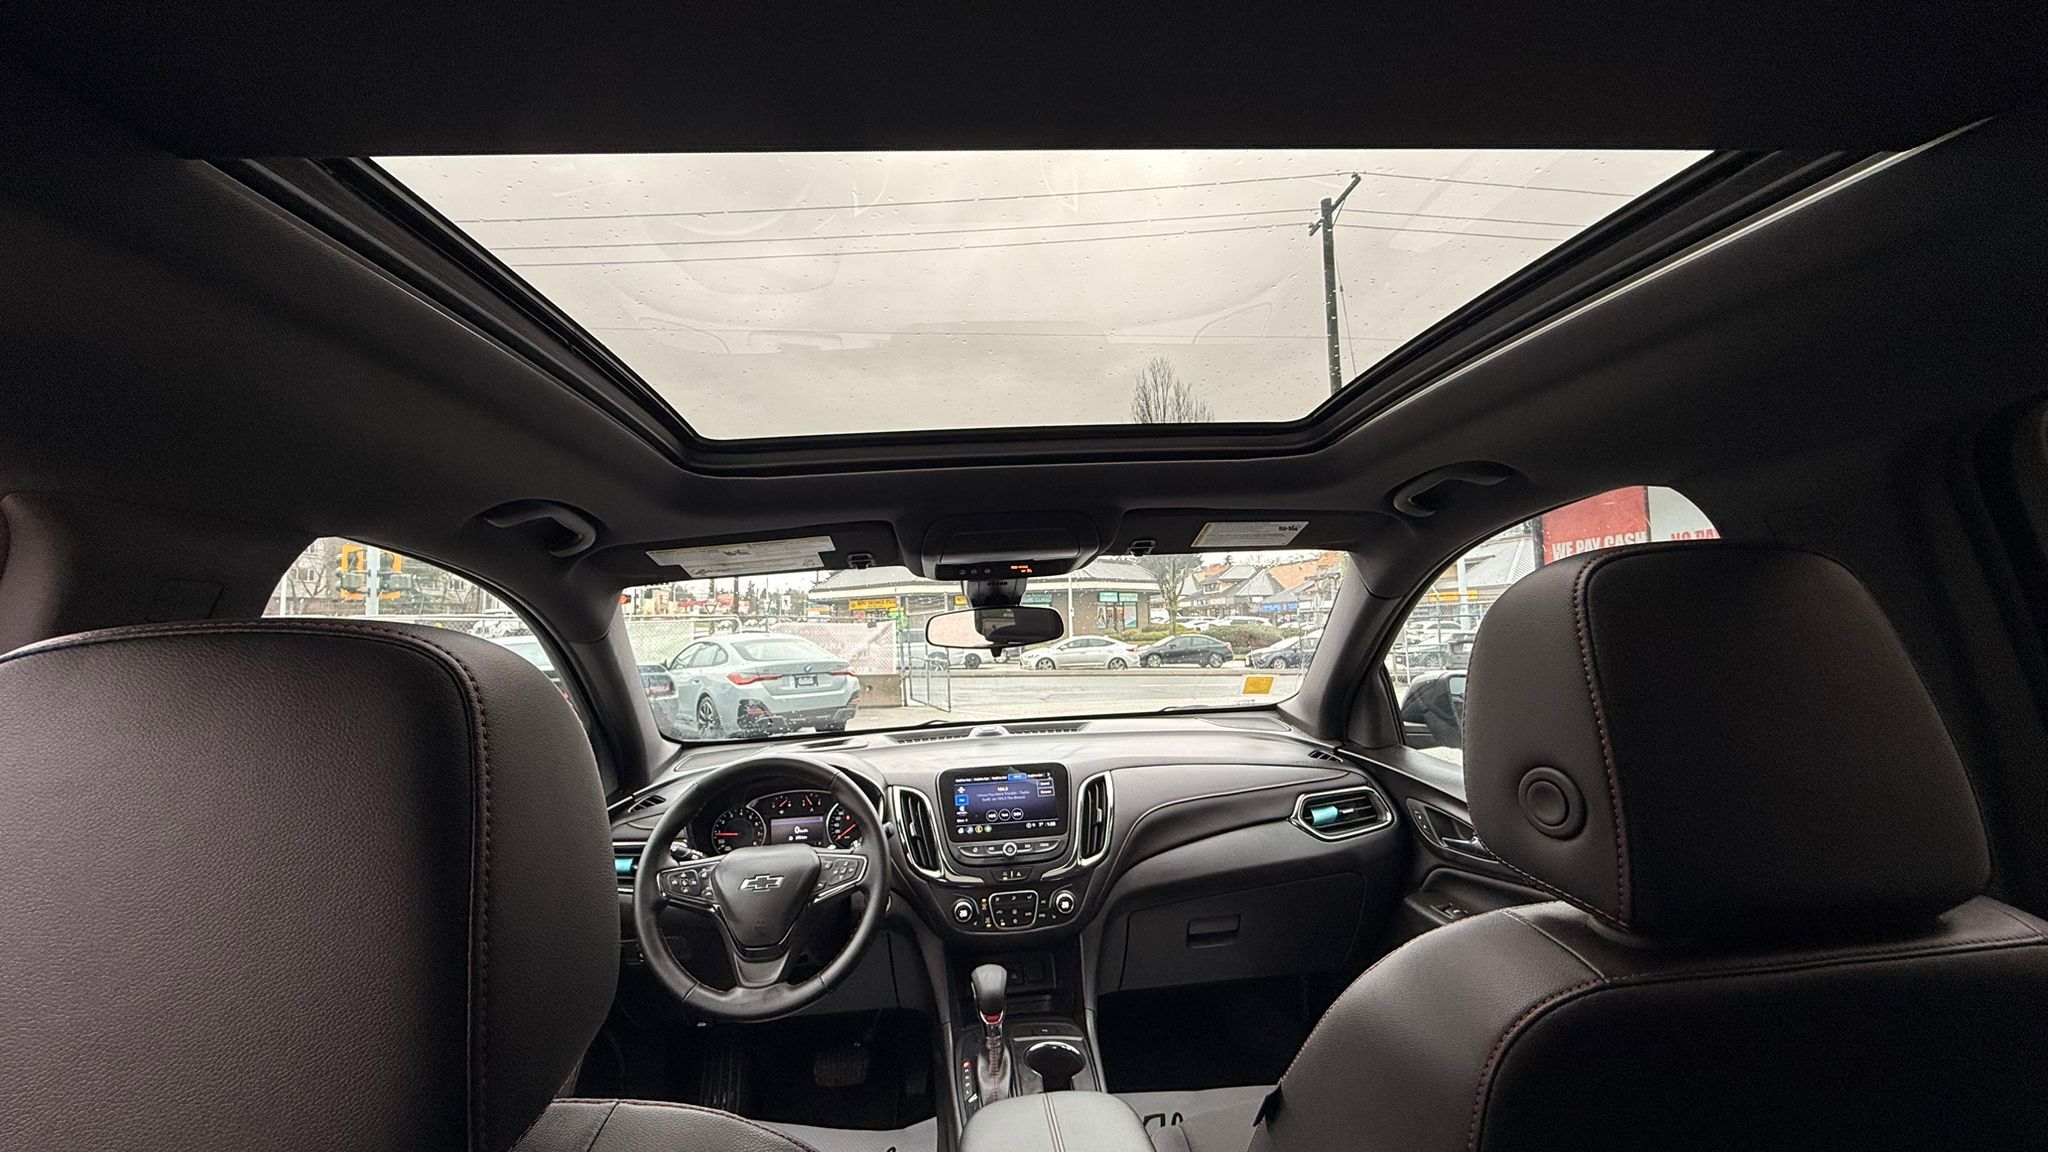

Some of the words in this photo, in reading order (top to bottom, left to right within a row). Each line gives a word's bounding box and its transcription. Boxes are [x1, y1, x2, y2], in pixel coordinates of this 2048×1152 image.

[1551, 541, 1573, 561] WE
[1575, 537, 1601, 553] PAY
[1604, 531, 1648, 548] CASH
